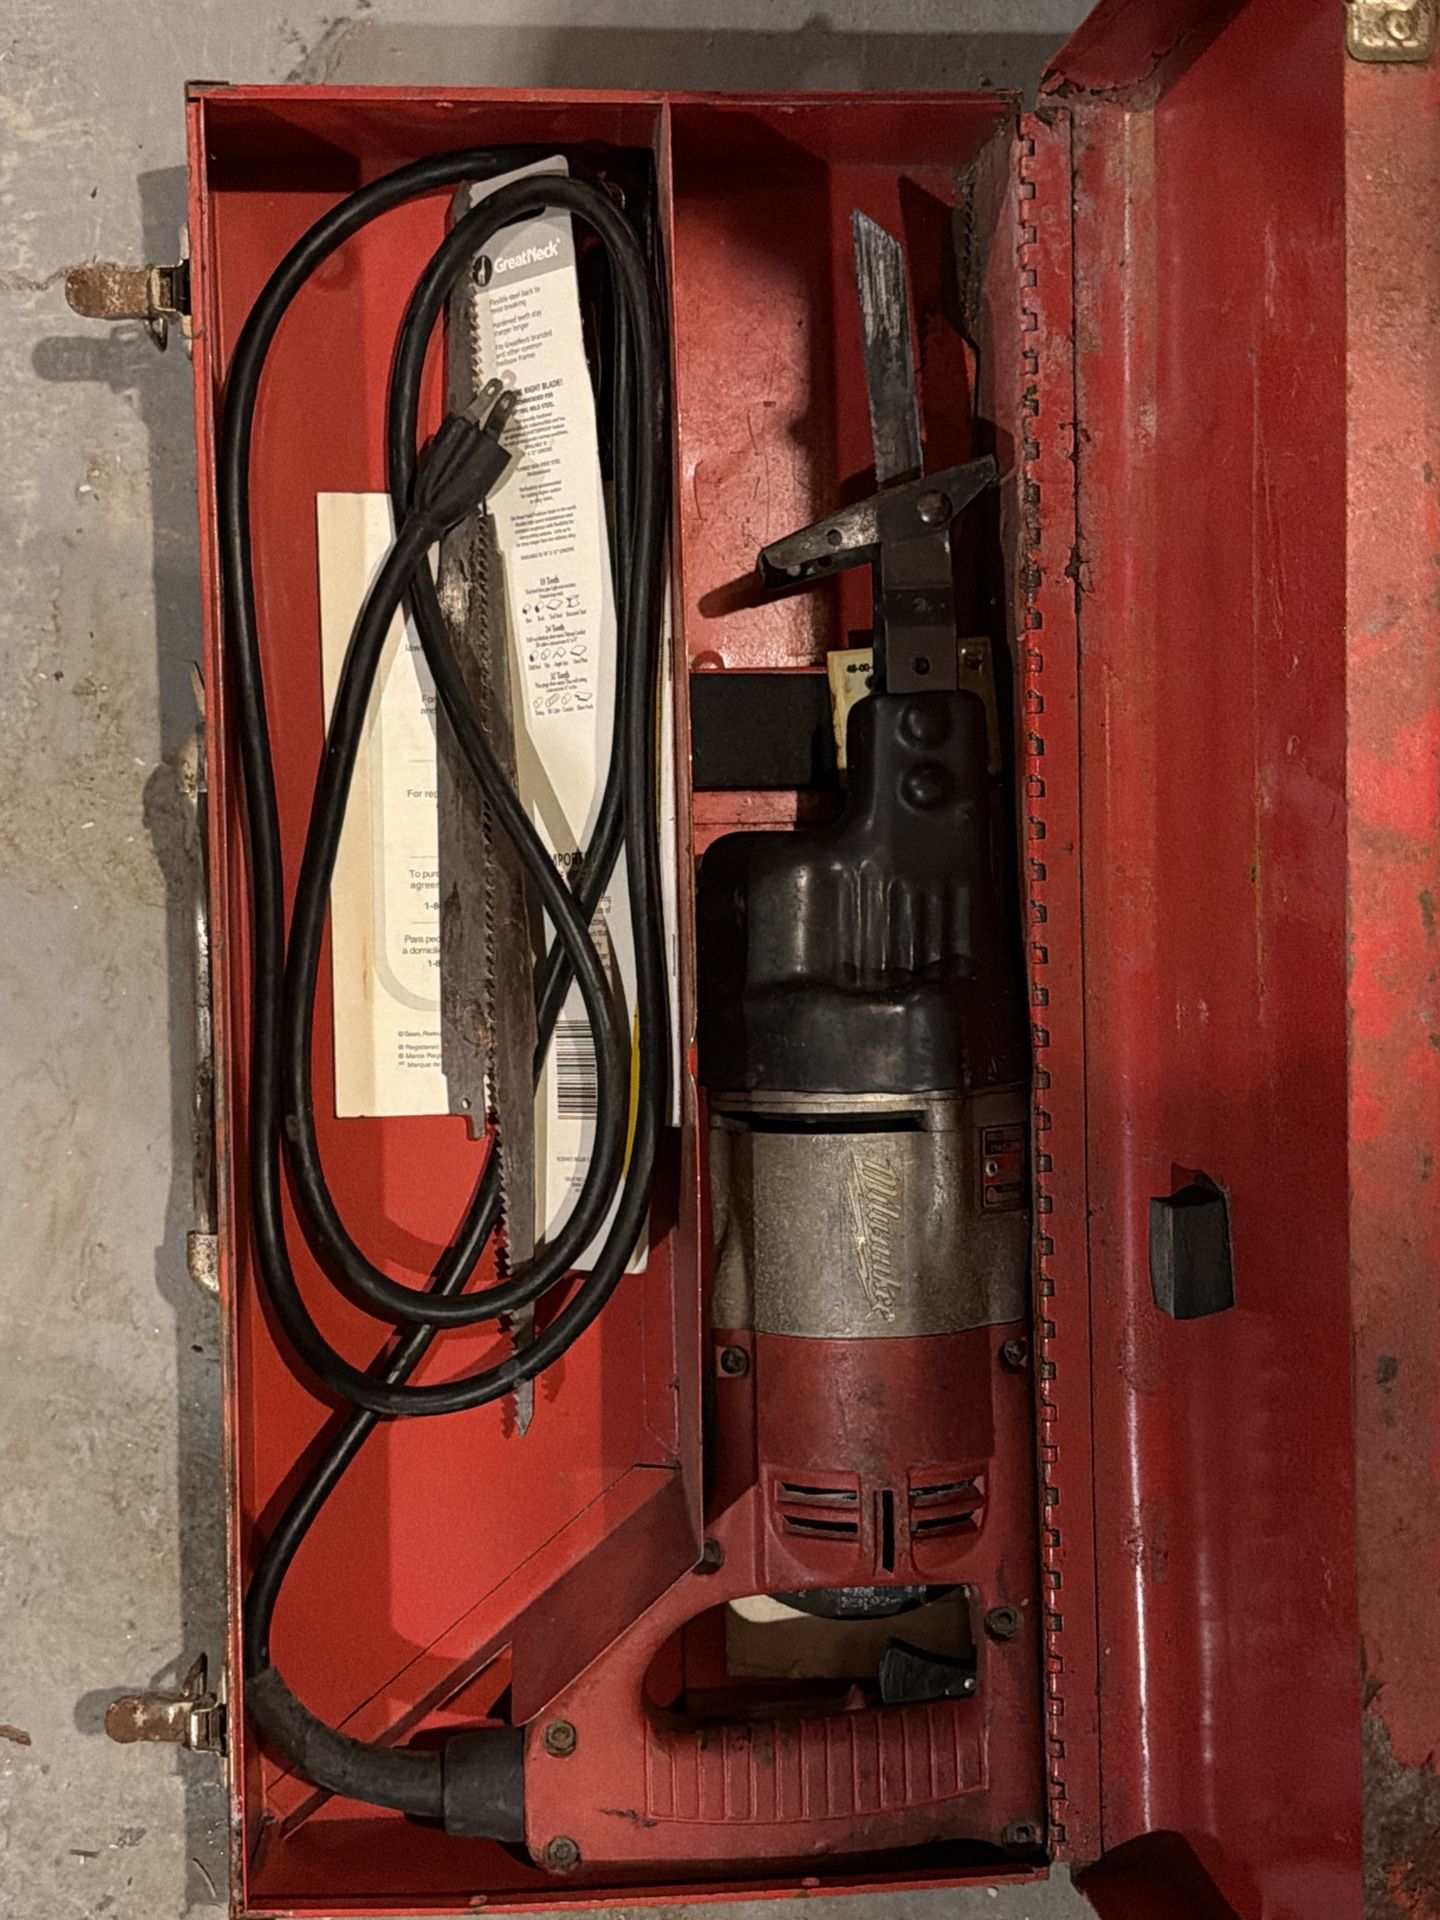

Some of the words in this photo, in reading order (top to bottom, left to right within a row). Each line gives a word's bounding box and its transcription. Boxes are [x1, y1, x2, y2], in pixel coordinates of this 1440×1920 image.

[494, 240, 559, 273] GreatNeck
[407, 789, 421, 798] For
[409, 869, 421, 878] To
